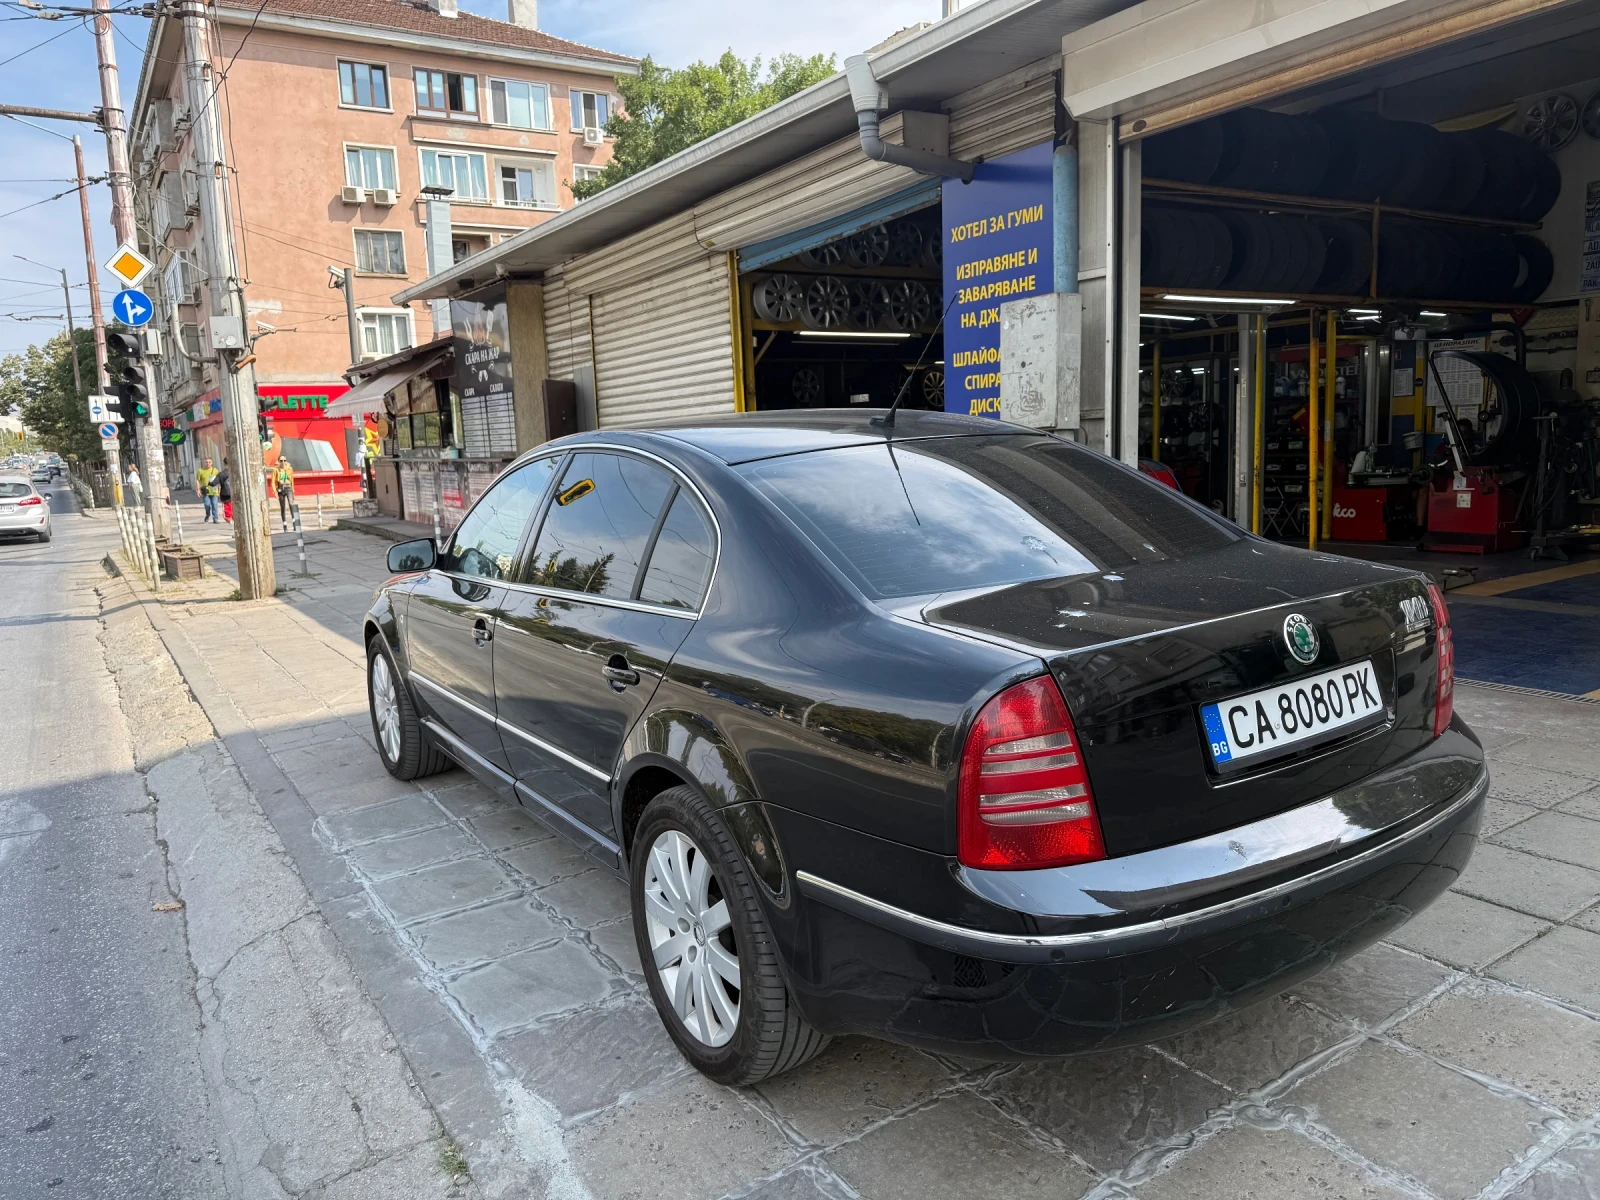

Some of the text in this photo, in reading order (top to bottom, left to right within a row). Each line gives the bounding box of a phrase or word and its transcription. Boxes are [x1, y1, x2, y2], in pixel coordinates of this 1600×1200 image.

[951, 204, 1044, 243] ХОТЕЛ ЗА ГУМИ
[956, 247, 1038, 281] ИЗПРАВЯНЕ И
[958, 275, 1036, 305] ЗАВАРЯВАНЕ
[961, 307, 1001, 329] НА ДЖ
[465, 346, 500, 365] СКАРА НА ЖАР
[1434, 338, 1481, 348] ЦЕНОРАЗПИС
[1228, 667, 1379, 748] CA 8080 PK
[1211, 741, 1229, 757] BG
